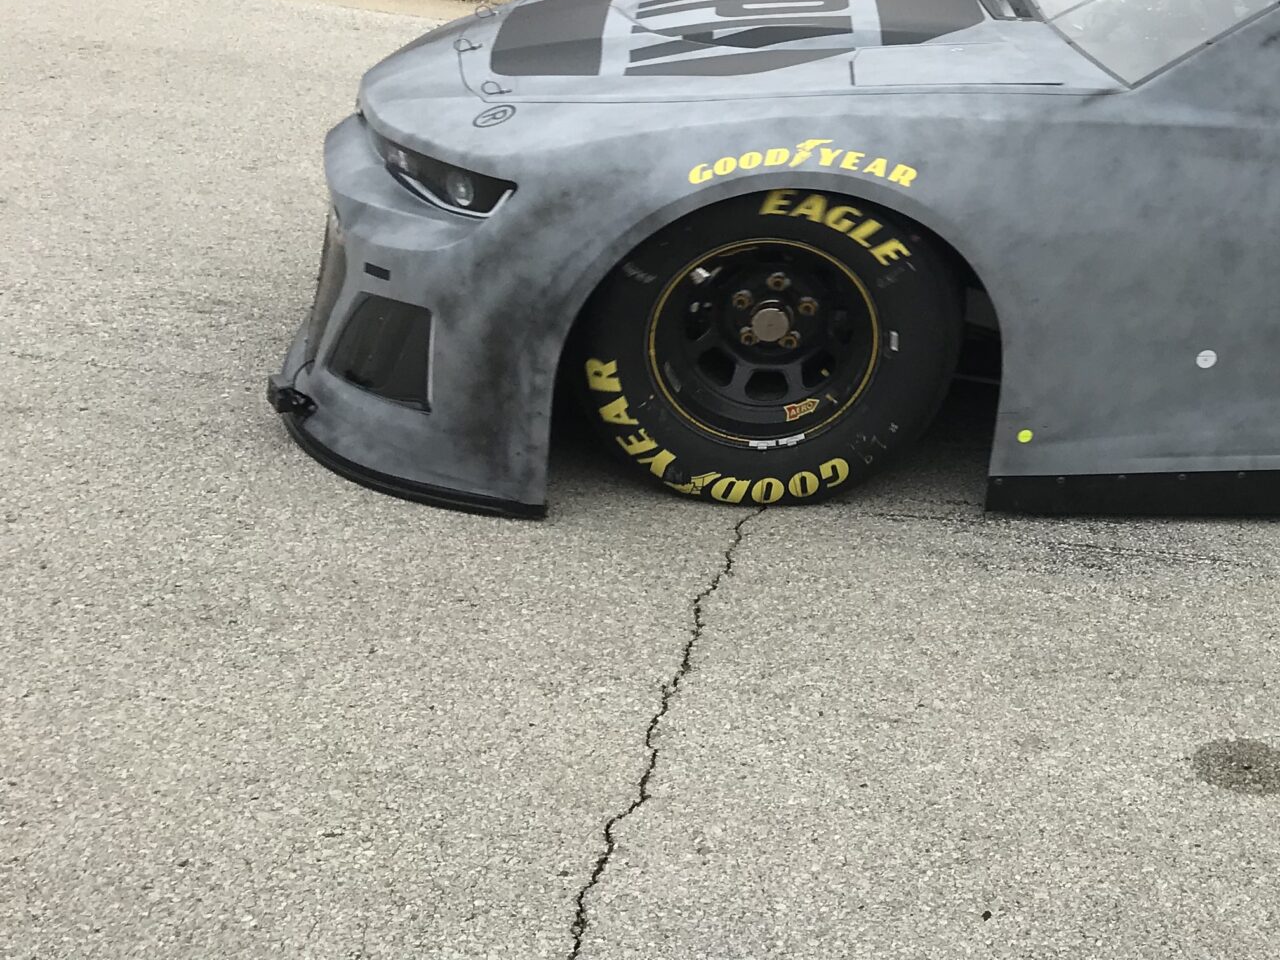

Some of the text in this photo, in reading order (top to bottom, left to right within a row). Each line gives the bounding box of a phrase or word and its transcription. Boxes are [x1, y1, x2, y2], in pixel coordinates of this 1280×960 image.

[688, 138, 918, 188] GOODYEAR
[758, 189, 912, 267] EAGLE
[585, 357, 850, 505] GOODYEAR
